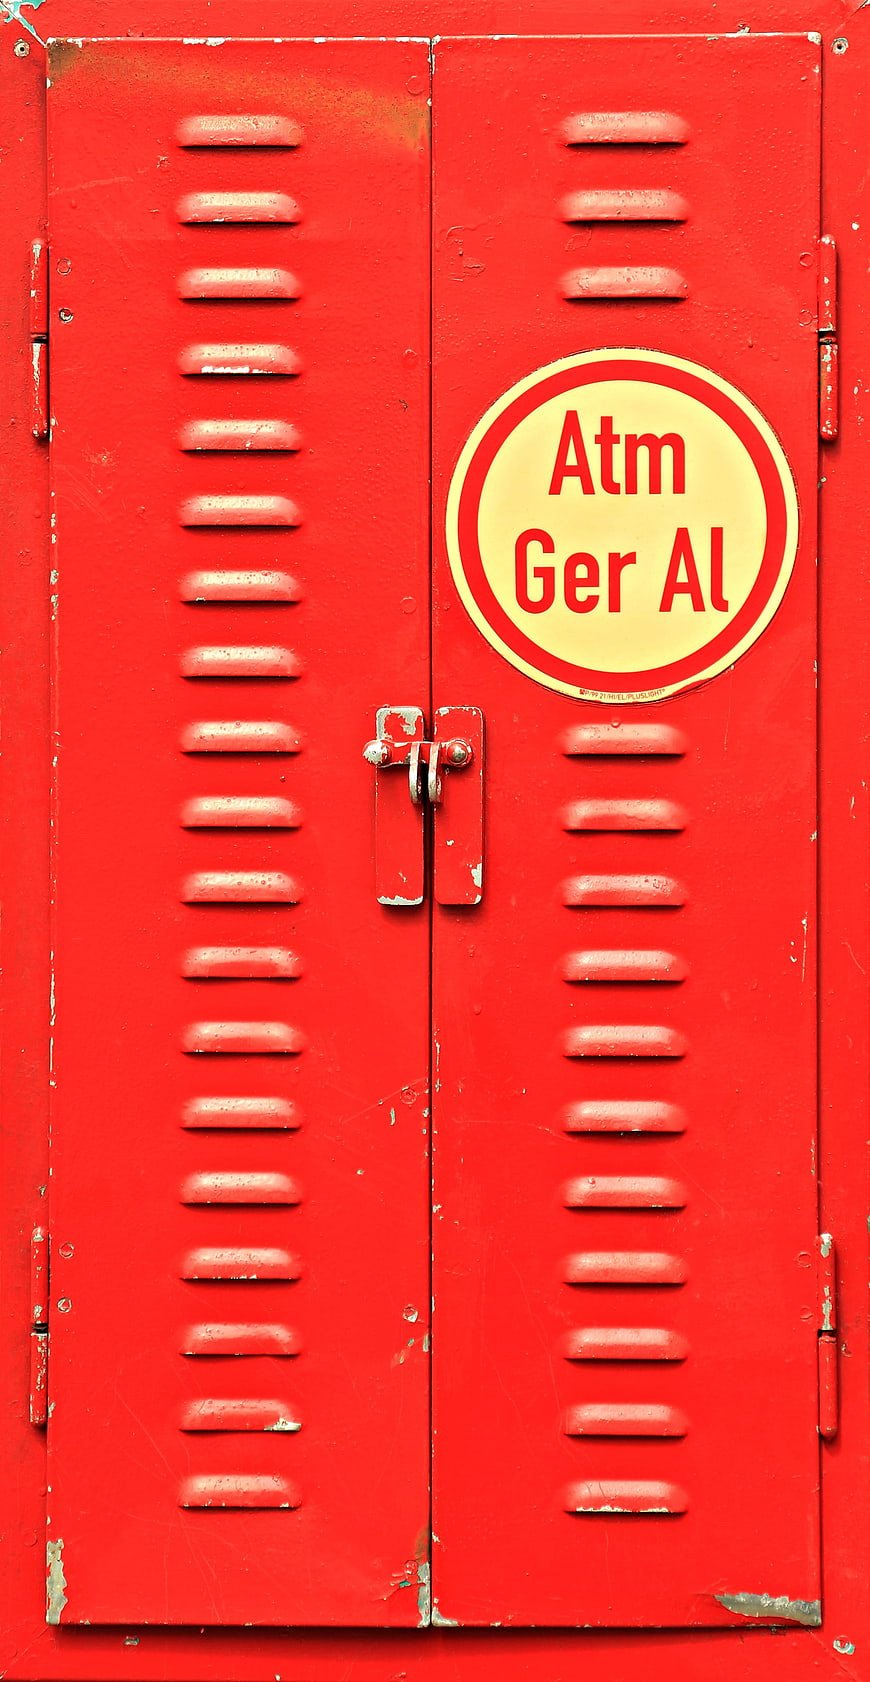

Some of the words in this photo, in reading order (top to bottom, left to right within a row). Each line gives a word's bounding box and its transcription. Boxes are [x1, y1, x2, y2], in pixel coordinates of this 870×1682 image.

[549, 410, 685, 495] Atm
[515, 527, 637, 614] Ger
[659, 527, 728, 613] Al
